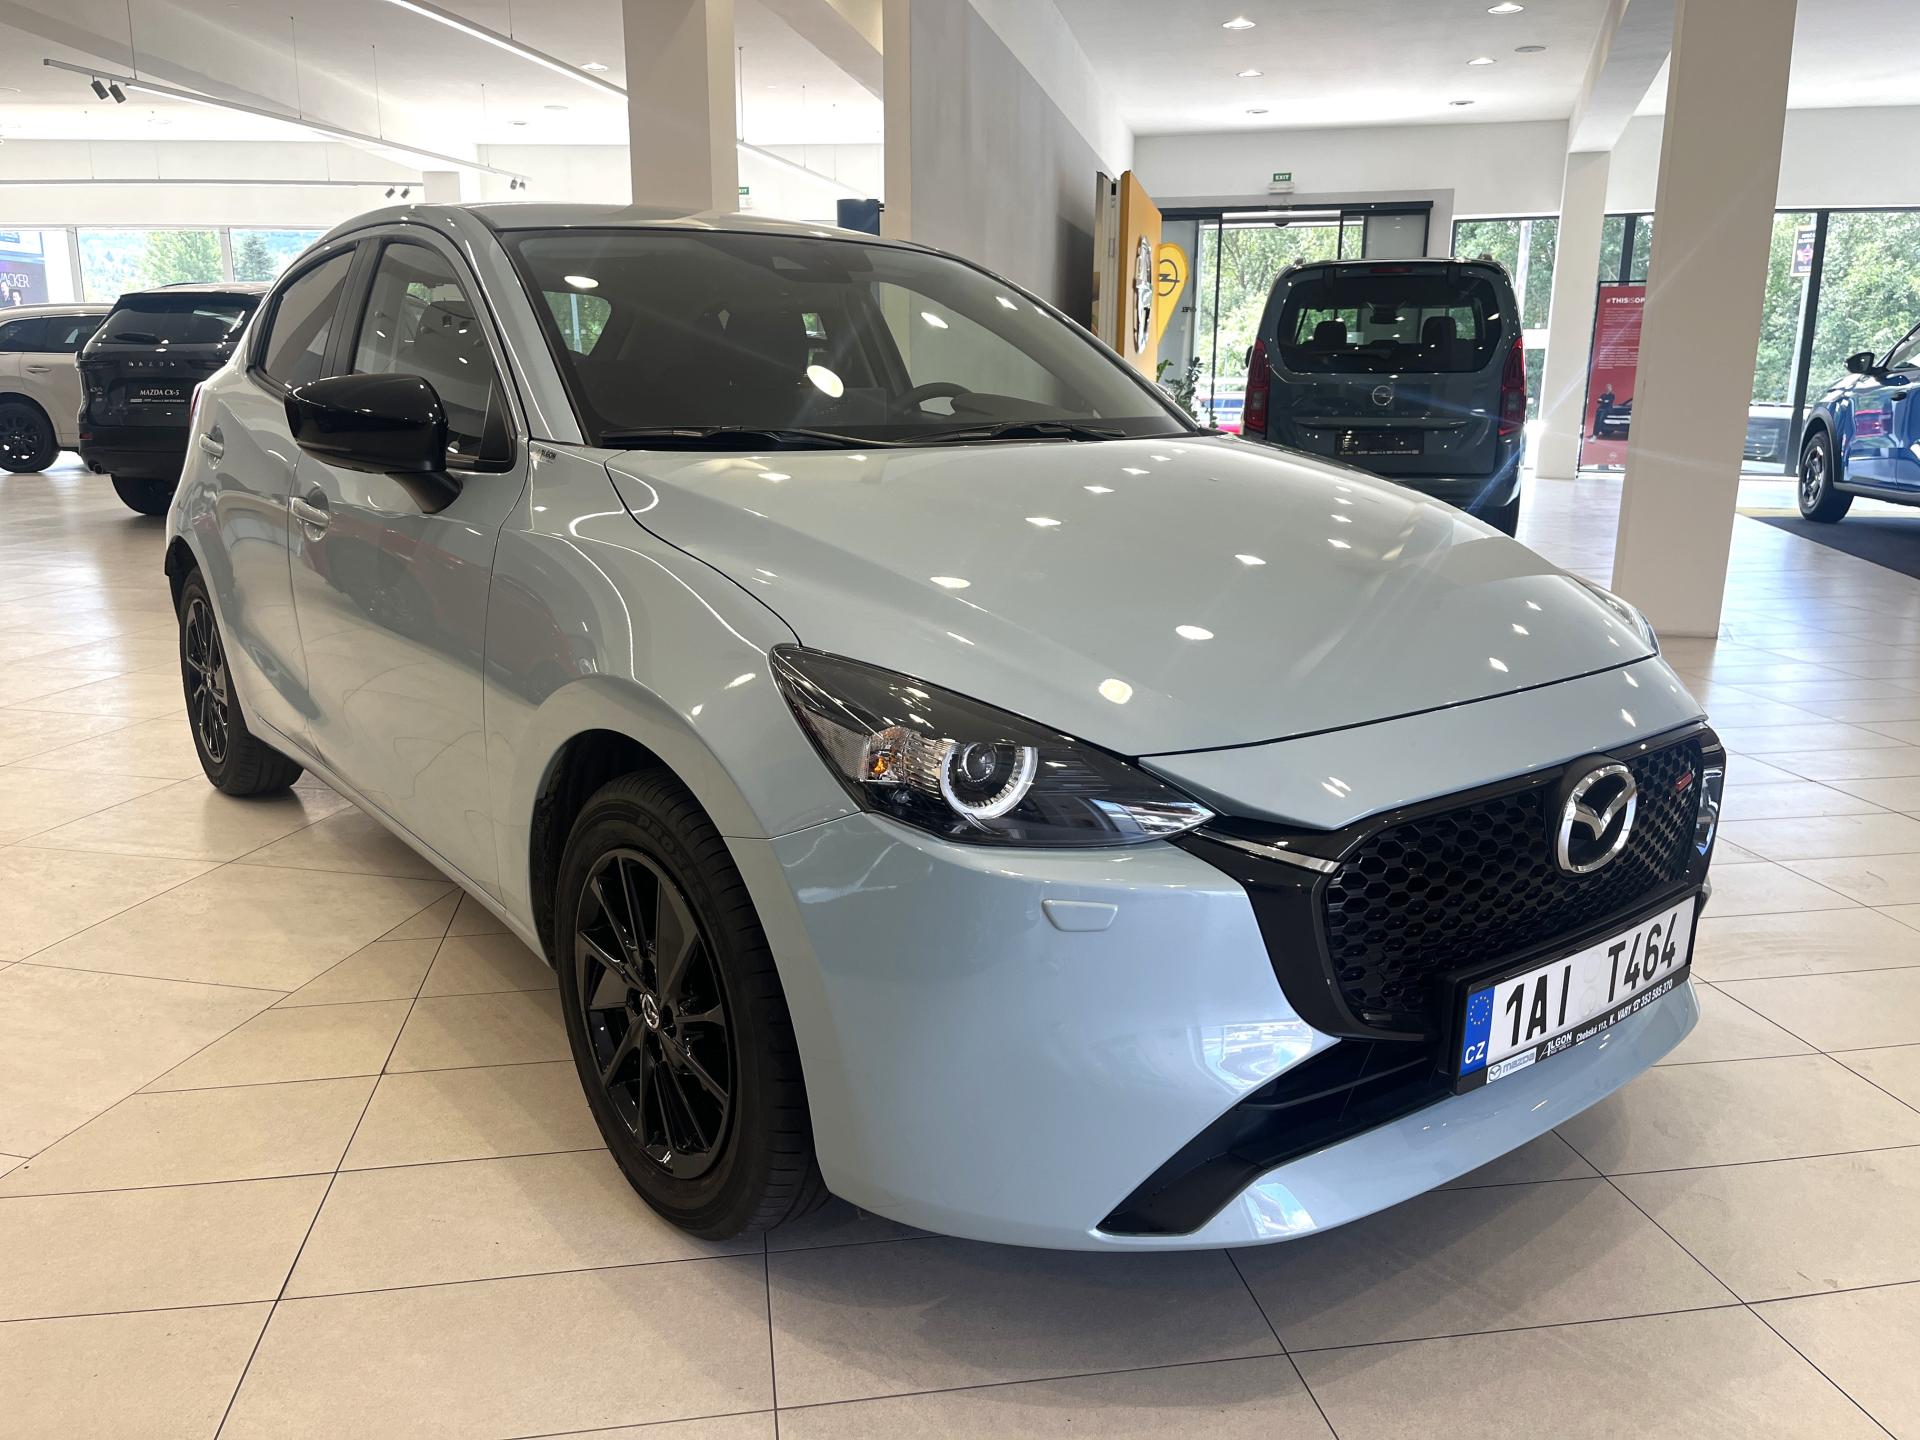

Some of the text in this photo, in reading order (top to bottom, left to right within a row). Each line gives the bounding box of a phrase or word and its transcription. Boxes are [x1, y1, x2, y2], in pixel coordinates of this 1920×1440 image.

[1506, 912, 1678, 1047] 1AI T464
[1617, 1003, 1633, 1021] VARY
[1464, 1041, 1486, 1064] CZ
[1539, 1032, 1573, 1060] ALGON
